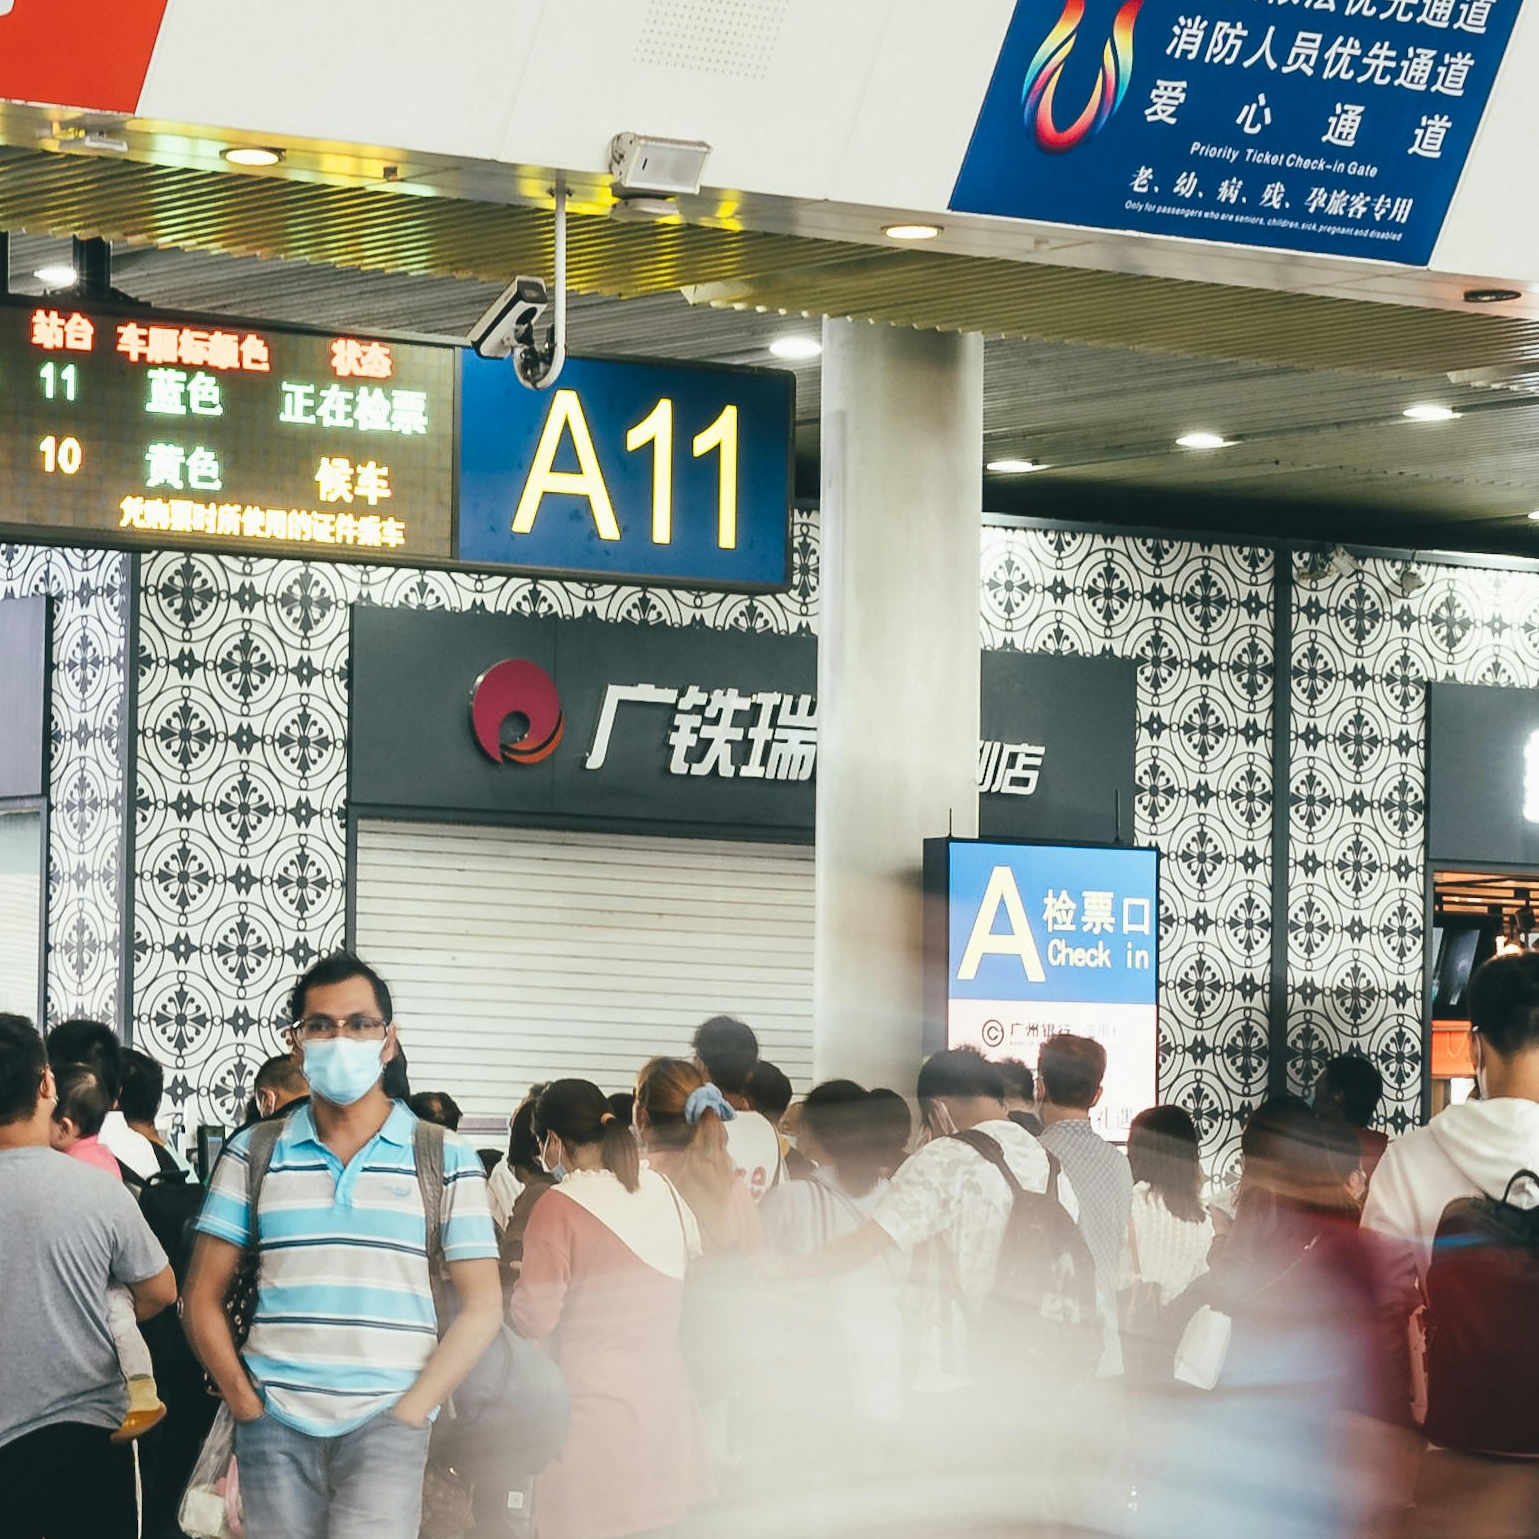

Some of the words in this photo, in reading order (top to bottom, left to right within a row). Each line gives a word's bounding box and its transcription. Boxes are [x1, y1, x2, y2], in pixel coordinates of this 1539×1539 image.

[1165, 14, 1475, 97] 消防人员优先通道
[1144, 78, 1453, 159] 爱心通道
[1128, 164, 1414, 225] 老、幼、病、残、孕旅客专用
[1189, 141, 1240, 164] Priority
[1245, 147, 1286, 167] Ticket
[1286, 153, 1345, 173] Check-in
[1347, 161, 1379, 179] Gate
[1124, 199, 1145, 213] Only
[1144, 201, 1157, 212] for
[1156, 205, 1204, 219] passengers
[1203, 210, 1221, 221] who
[1220, 213, 1235, 223] are
[1368, 229, 1404, 242] disabled
[31, 308, 95, 353] 站台
[330, 338, 393, 379] 状态
[39, 361, 77, 402] 11
[145, 366, 224, 417] 蓝色
[278, 380, 430, 435] 正在检票
[38, 435, 83, 476] 10
[144, 442, 223, 491] 黄色
[314, 457, 393, 506] 候车
[512, 388, 739, 550] A11
[584, 682, 817, 781] 广铁瑞
[956, 865, 1047, 983] A
[1042, 888, 1151, 936] 检票口
[1047, 937, 1112, 969] Check
[1125, 940, 1150, 971] in
